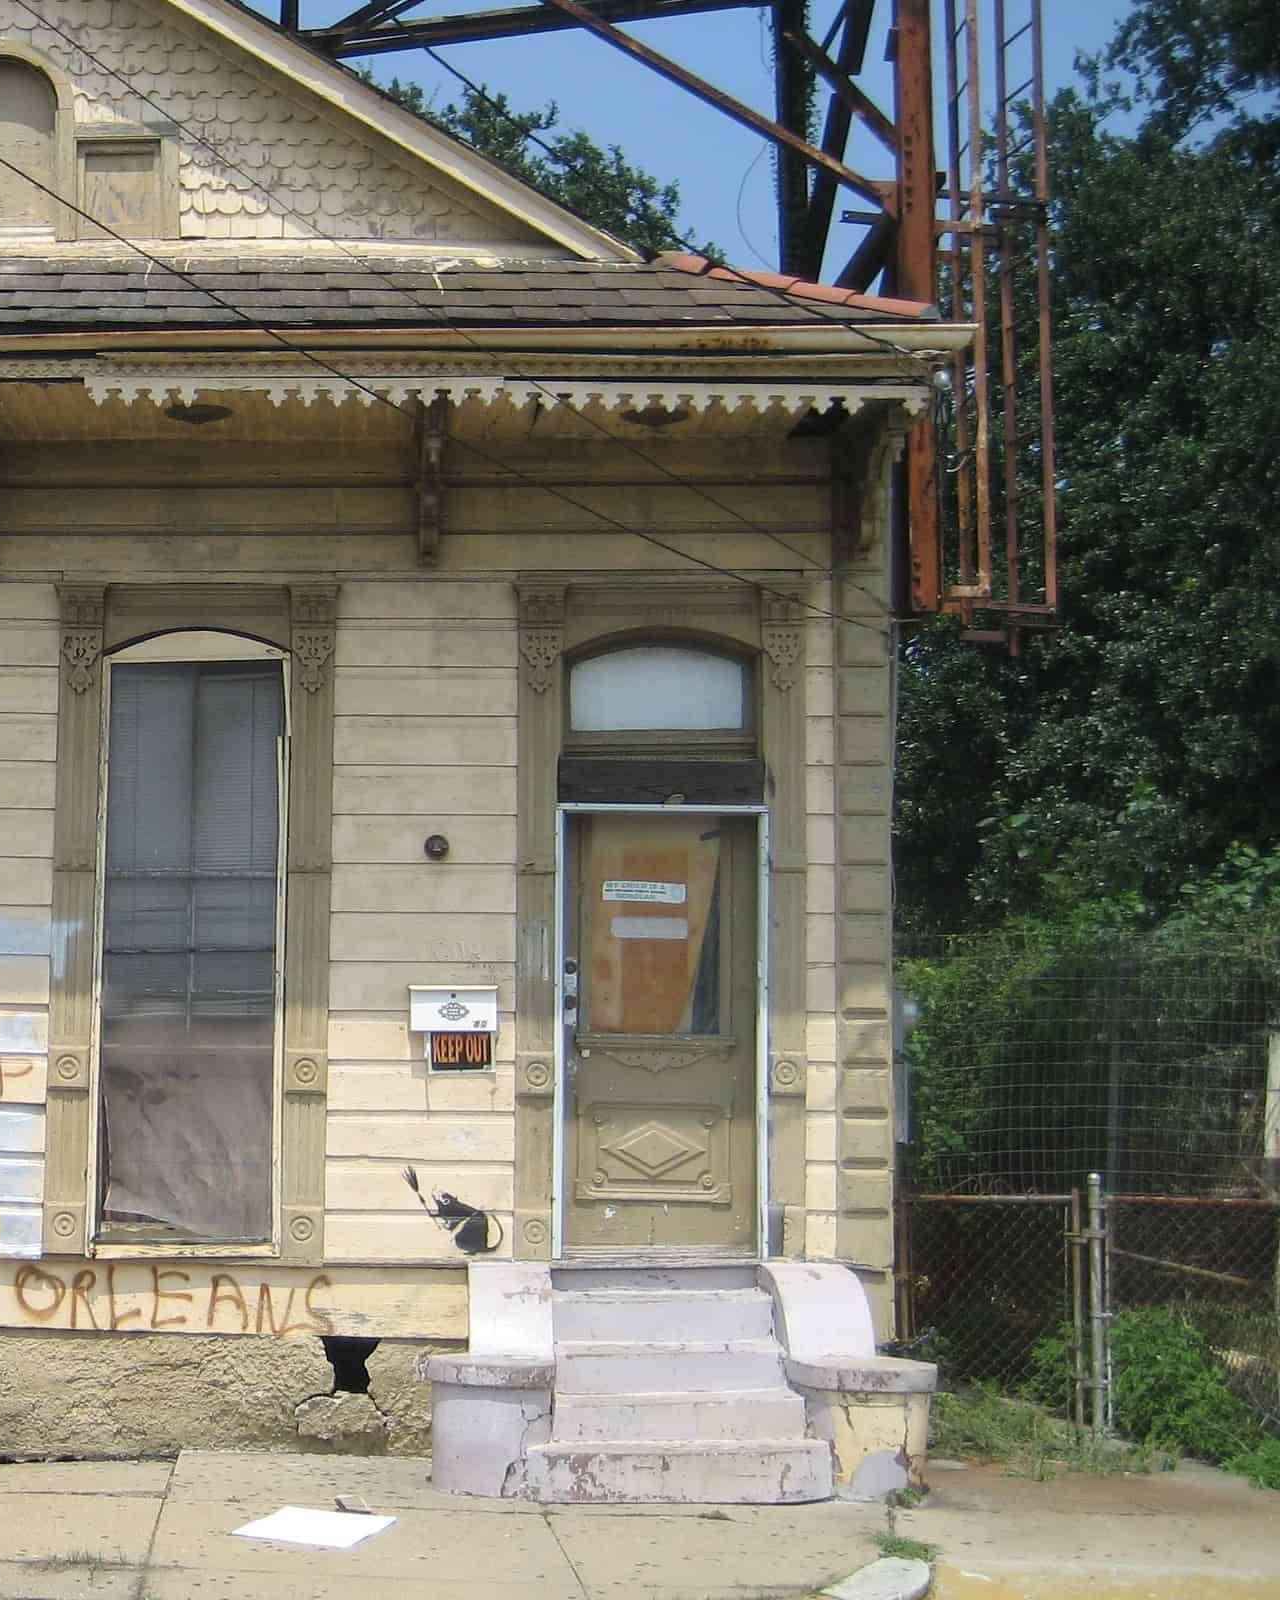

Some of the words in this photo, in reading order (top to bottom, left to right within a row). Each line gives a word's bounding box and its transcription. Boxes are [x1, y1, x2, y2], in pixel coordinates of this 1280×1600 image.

[432, 1034, 463, 1064] KEEP
[465, 1034, 488, 1063] OUT
[17, 1262, 334, 1337] ORLEANS
